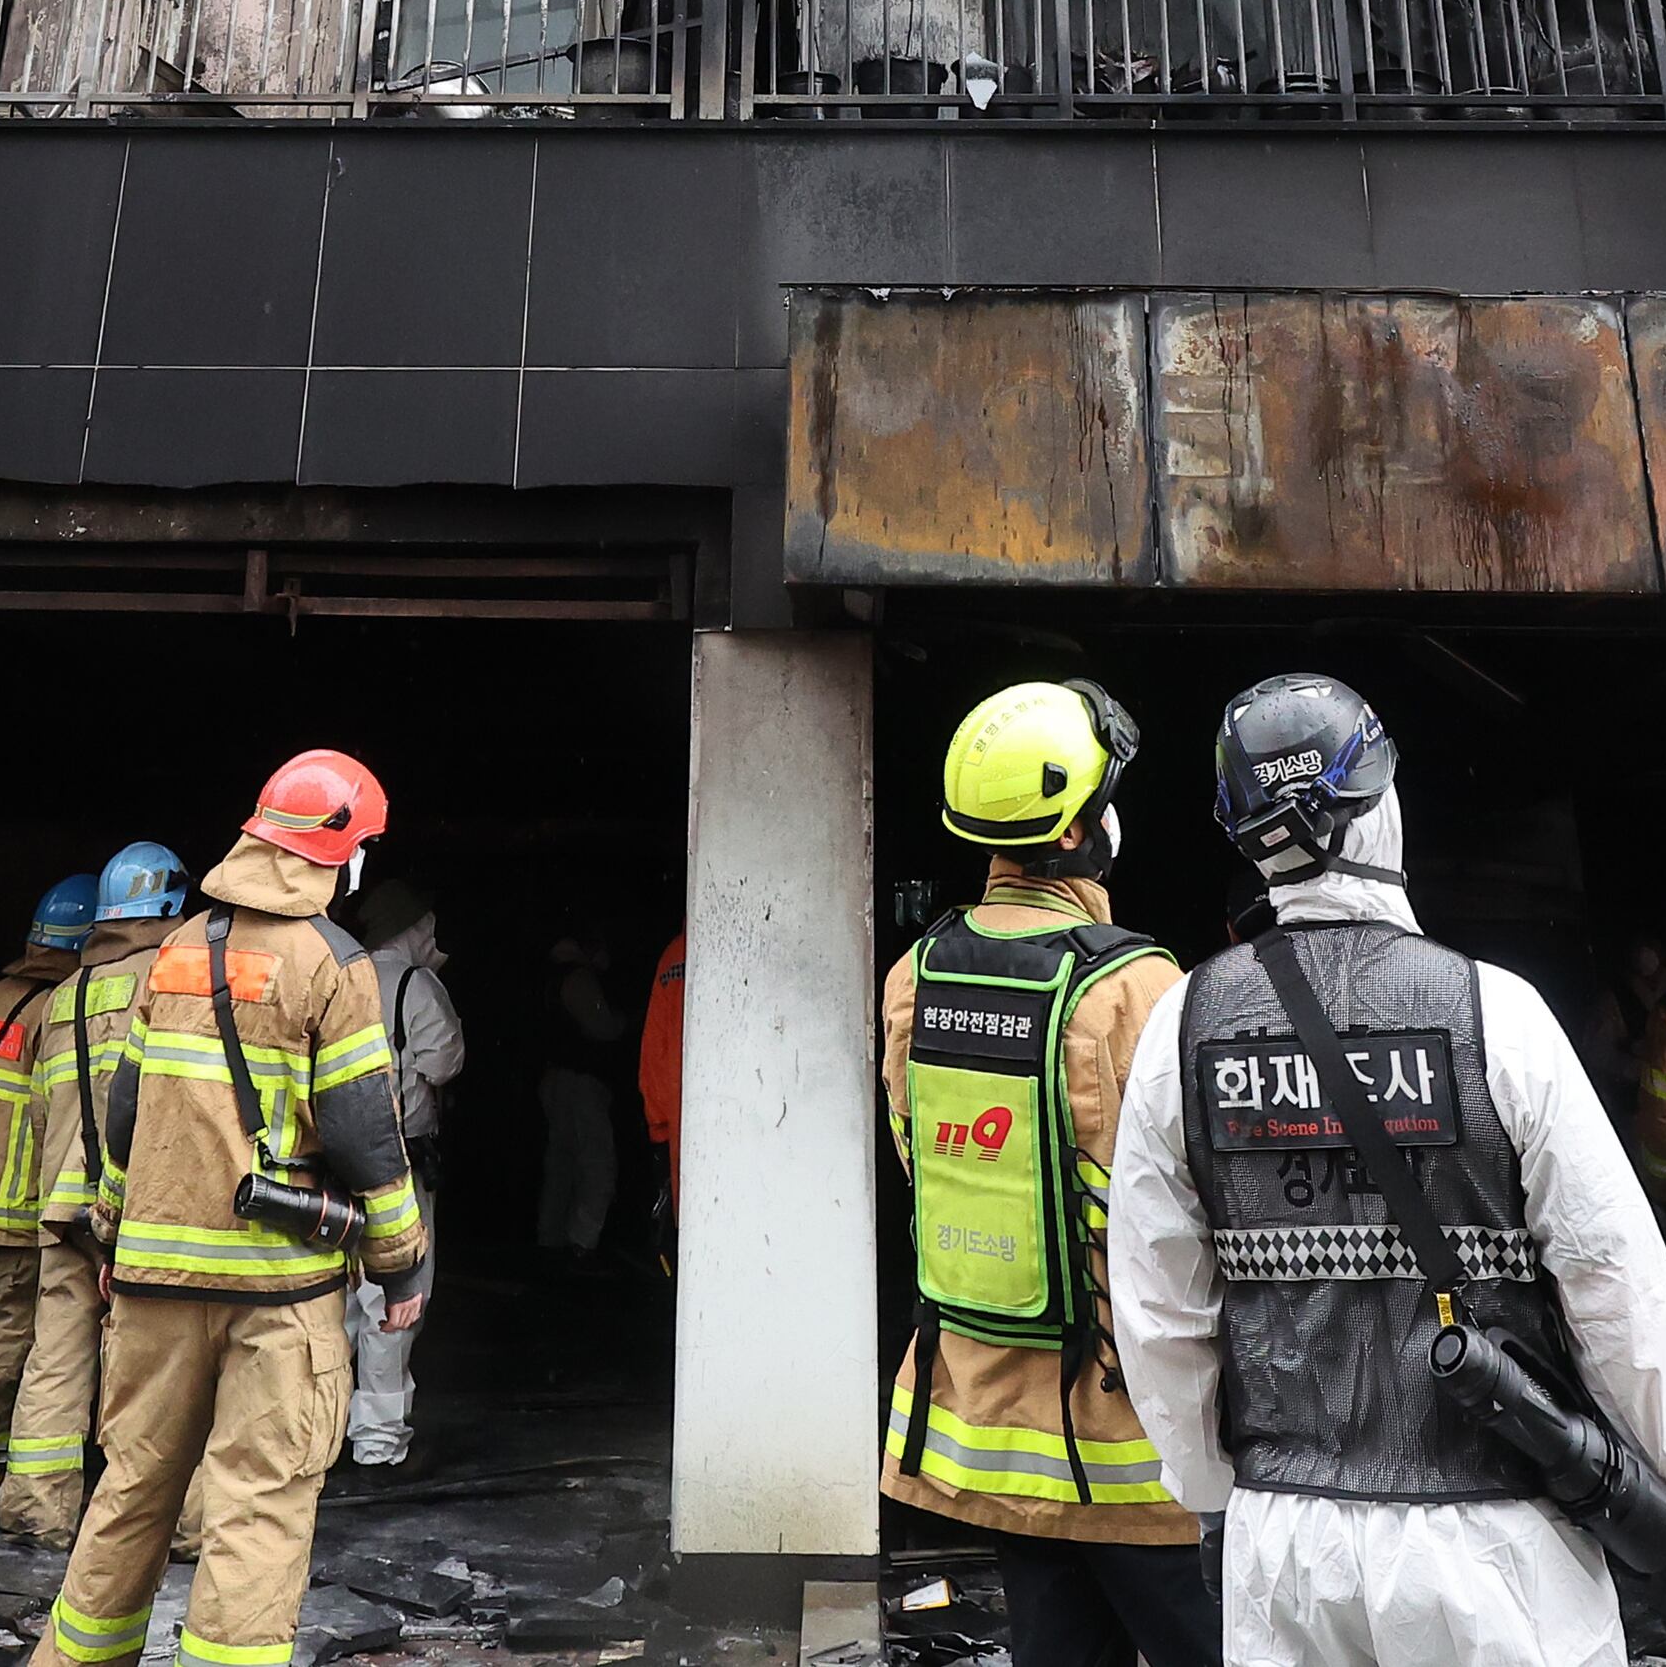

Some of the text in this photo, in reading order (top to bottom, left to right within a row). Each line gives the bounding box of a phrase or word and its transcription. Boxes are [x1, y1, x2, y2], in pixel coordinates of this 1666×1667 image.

[1253, 749, 1323, 788] 경기소방
[923, 1006, 1032, 1039] 현장안전점검관
[934, 1106, 1012, 1162] 119
[1267, 1118, 1319, 1137] Scene
[1322, 1115, 1440, 1137] Ingation
[937, 1224, 1016, 1262] 경기도소방
